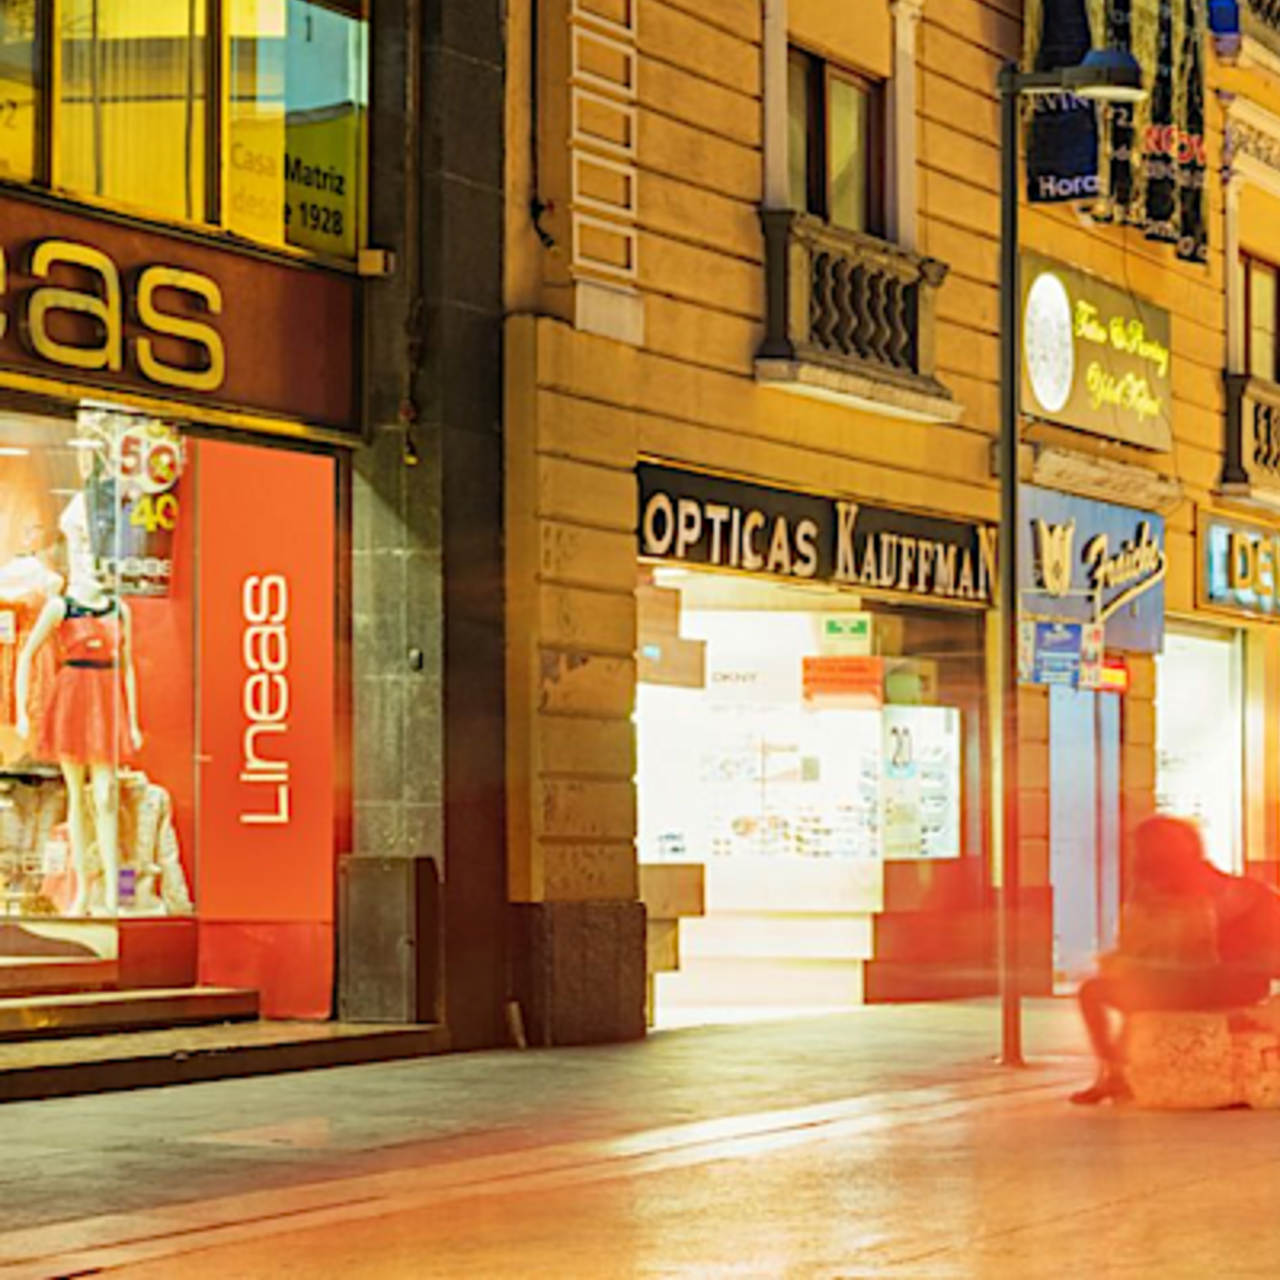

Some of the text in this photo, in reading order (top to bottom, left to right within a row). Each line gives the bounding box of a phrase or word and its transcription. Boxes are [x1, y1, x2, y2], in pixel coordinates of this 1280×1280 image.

[283, 150, 346, 197] Matriz
[299, 202, 345, 237] 1928
[643, 492, 818, 578] OPTICAS
